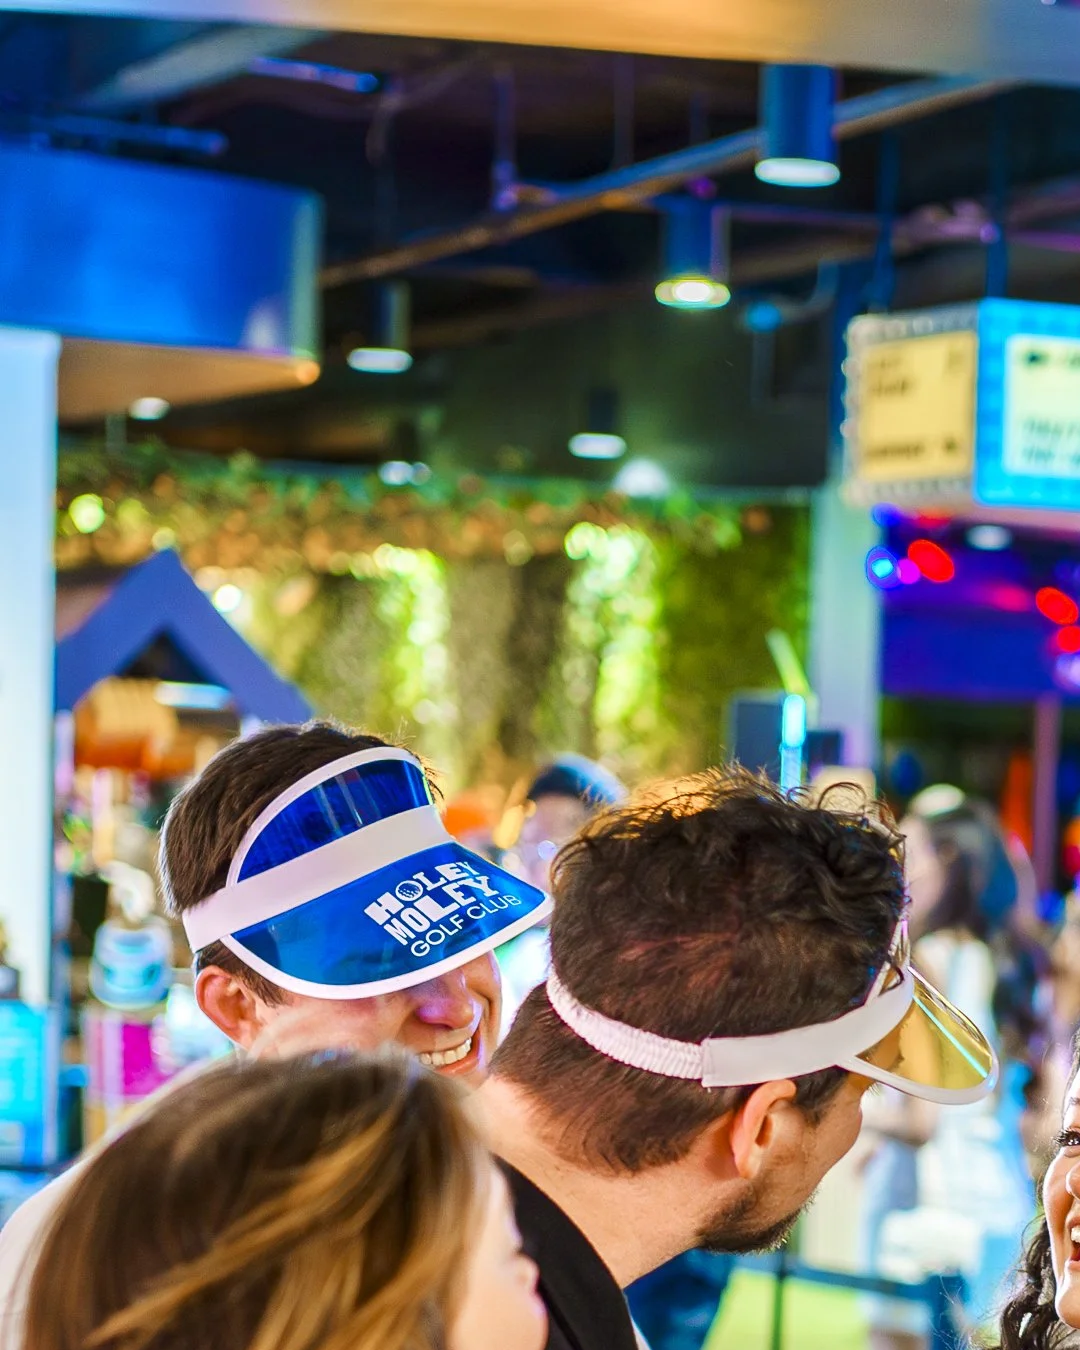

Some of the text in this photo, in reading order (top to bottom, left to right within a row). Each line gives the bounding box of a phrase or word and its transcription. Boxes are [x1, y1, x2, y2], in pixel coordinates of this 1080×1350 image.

[364, 861, 480, 925] HOLEY
[383, 876, 499, 945] MOLEY
[411, 894, 522, 957] GOLF CLUB
